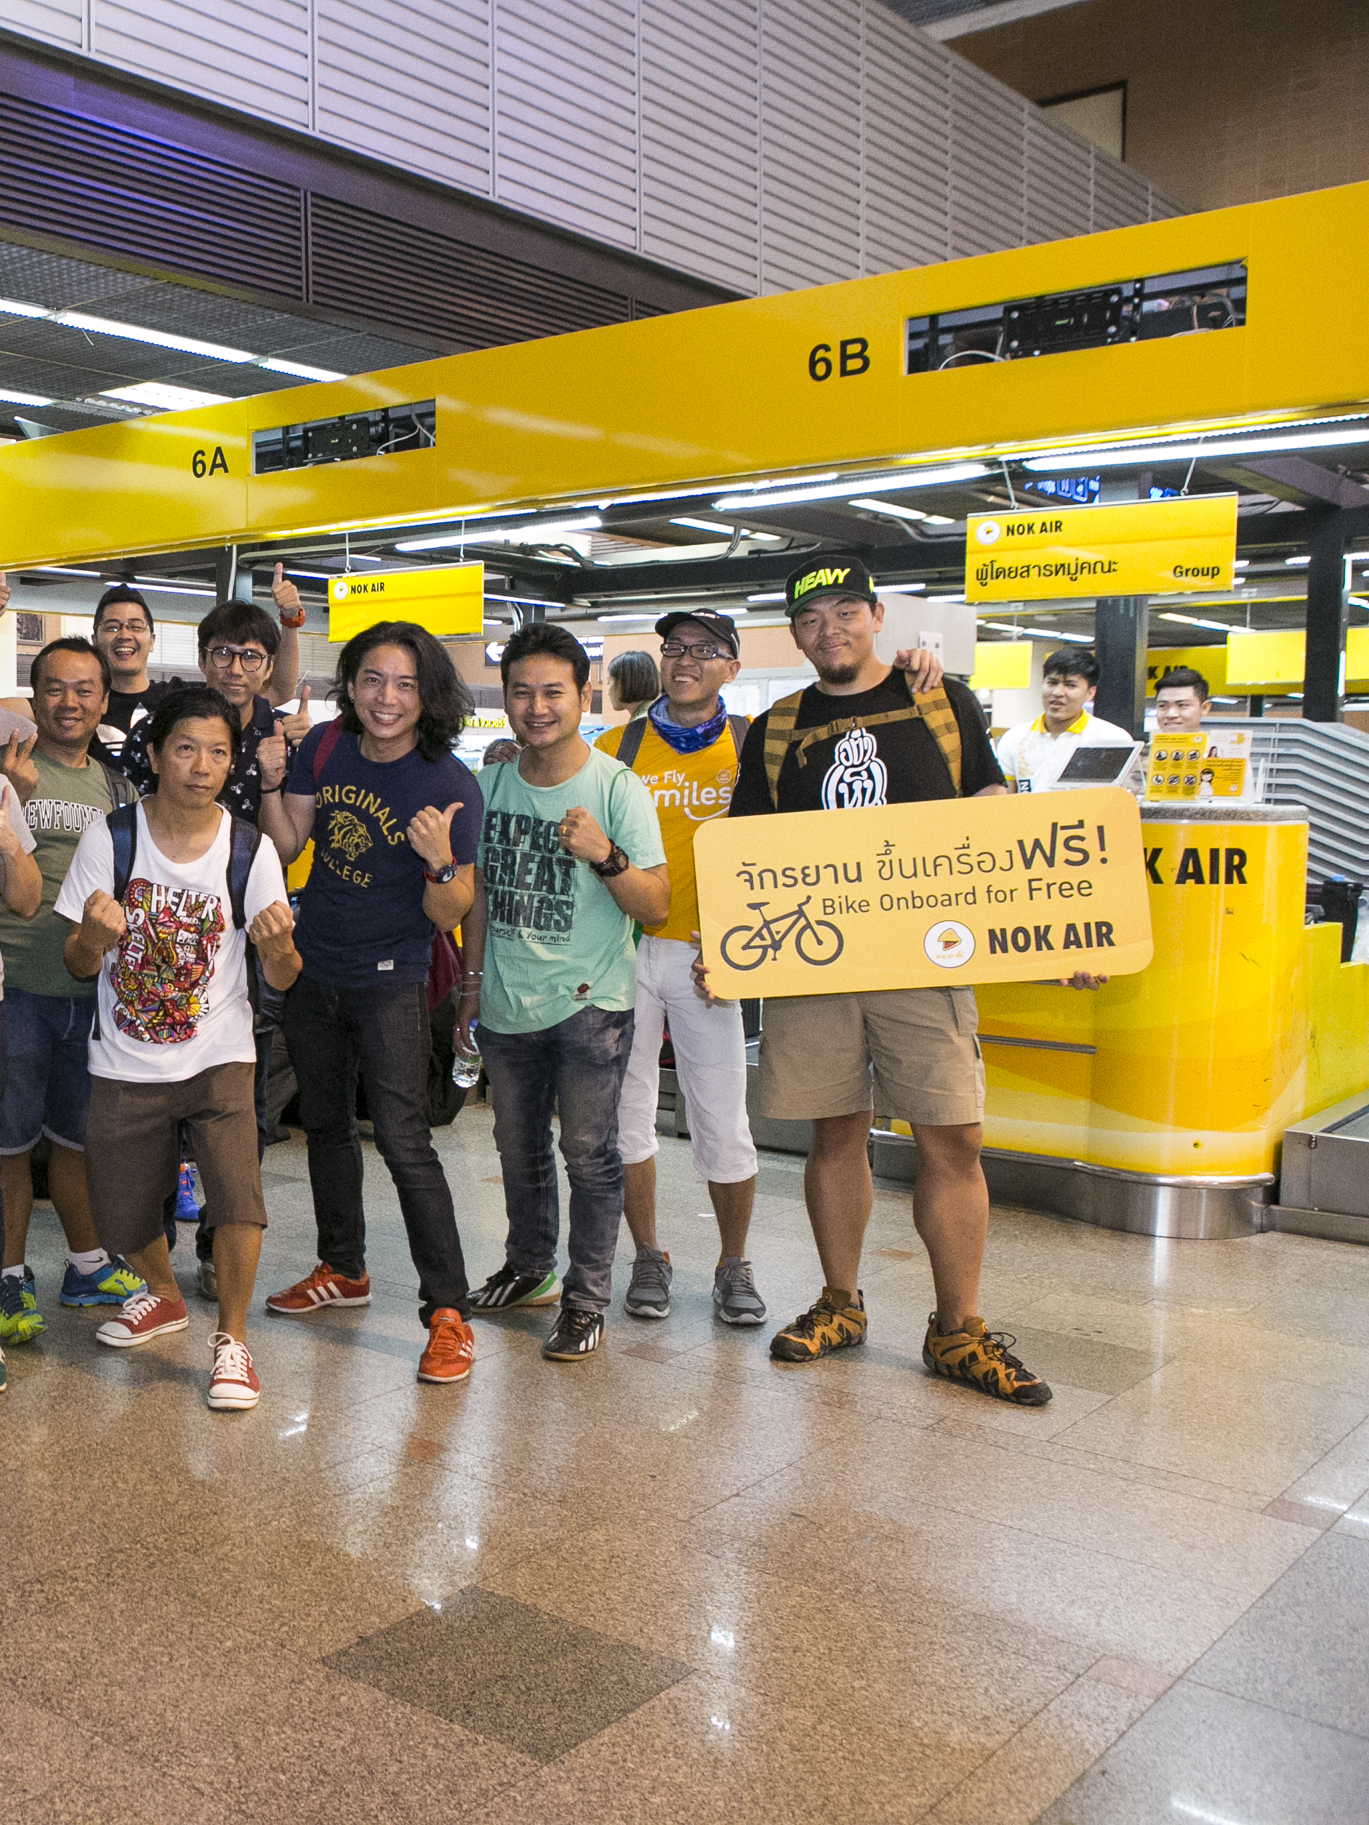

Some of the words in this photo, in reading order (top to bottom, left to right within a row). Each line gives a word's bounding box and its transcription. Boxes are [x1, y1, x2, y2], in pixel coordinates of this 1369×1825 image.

[808, 337, 871, 382] 6B
[192, 446, 229, 479] 6A
[1006, 523, 1035, 537] NOK
[1039, 520, 1063, 534] AIR
[794, 568, 851, 599] HEAVY
[975, 557, 1119, 587] ผู้โดยสารหมู่คณะ
[1172, 564, 1221, 580] Group
[350, 583, 368, 595] NOK
[371, 581, 385, 594] AIR
[664, 770, 686, 787] Fly
[646, 781, 732, 808] miles
[484, 811, 572, 857] EXPEC
[485, 846, 577, 897] GREAT
[735, 861, 862, 892] จักรยาน
[1174, 847, 1248, 885] AIR
[822, 896, 871, 917] Bike
[879, 887, 978, 912] Onboard
[985, 884, 1018, 904] for
[1028, 877, 1094, 903] Free
[988, 924, 1055, 955] NOK
[1063, 920, 1116, 950] AIR
